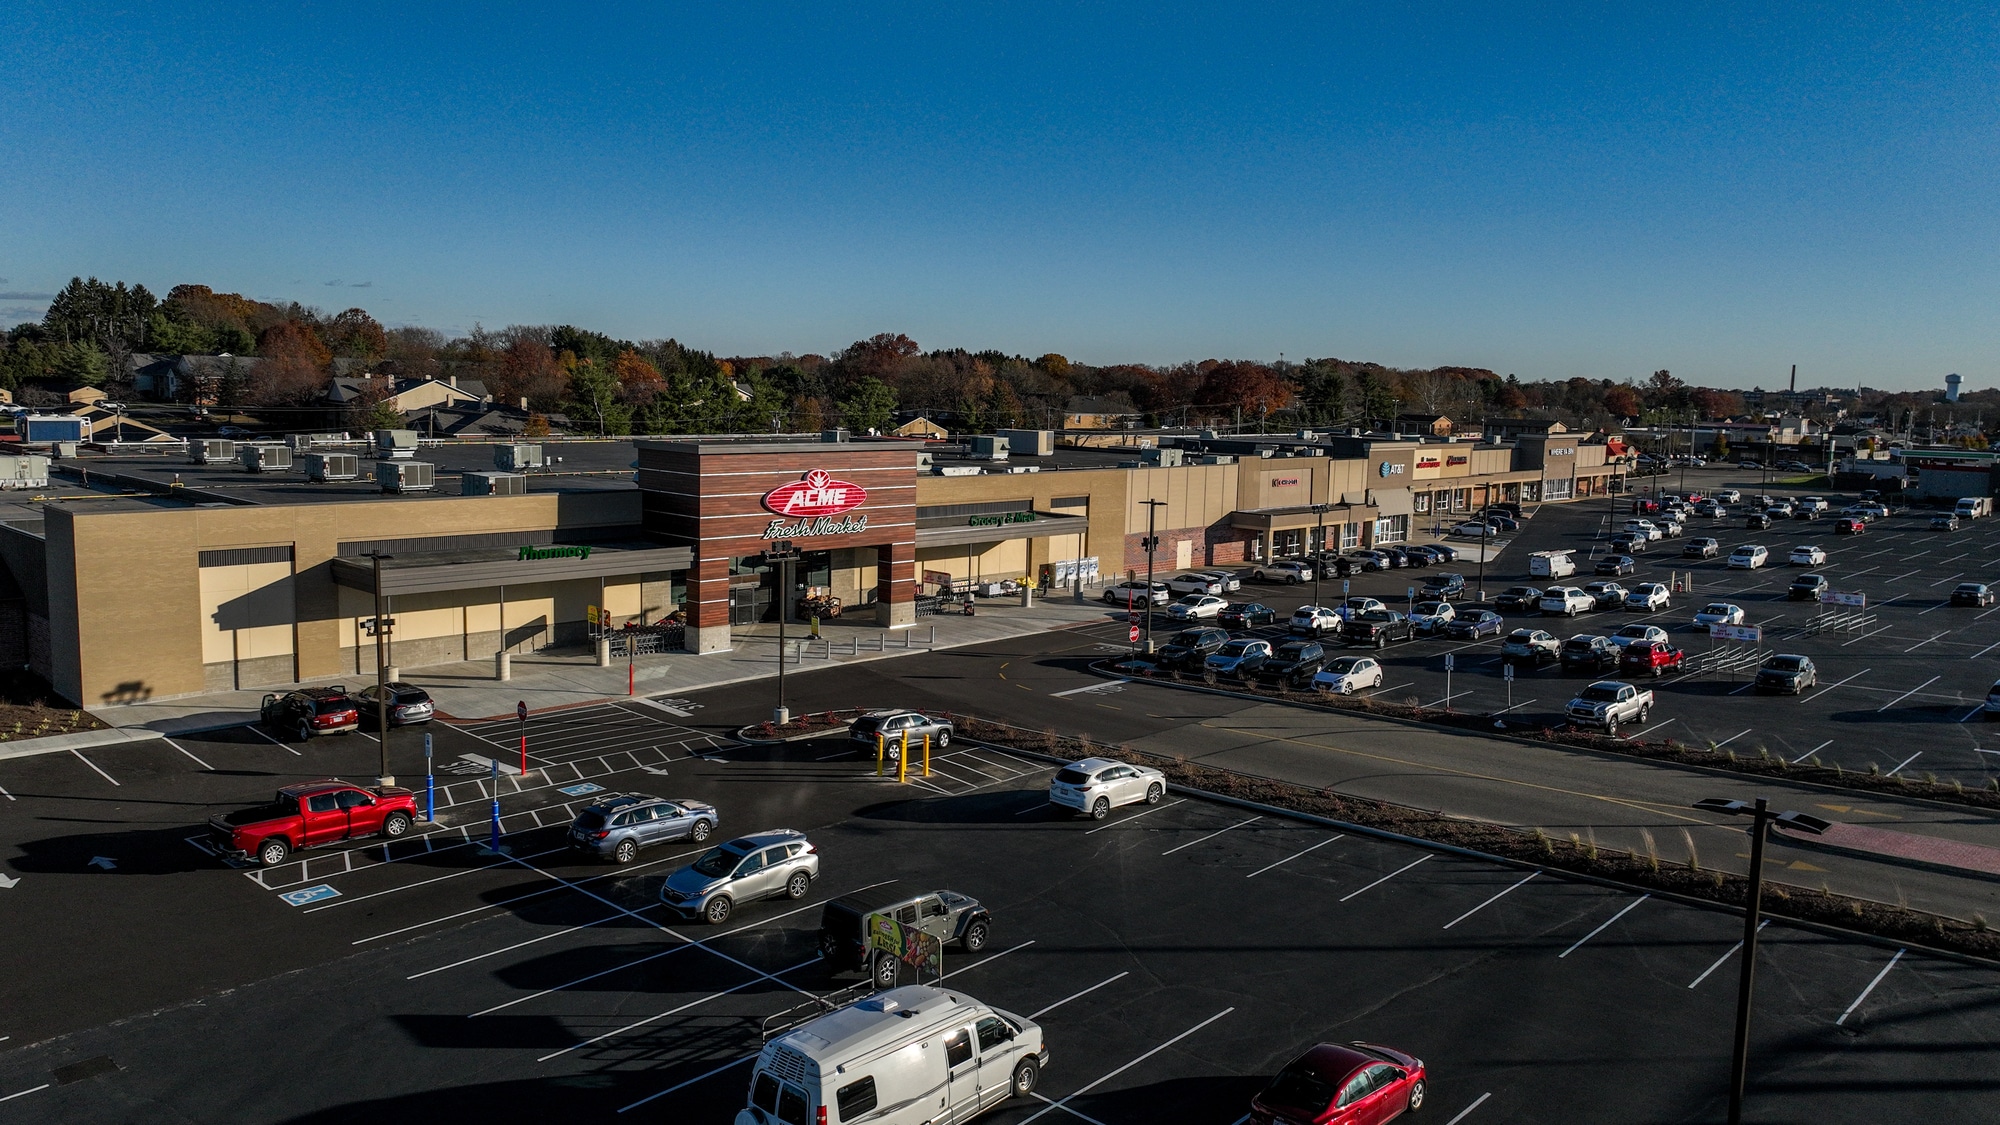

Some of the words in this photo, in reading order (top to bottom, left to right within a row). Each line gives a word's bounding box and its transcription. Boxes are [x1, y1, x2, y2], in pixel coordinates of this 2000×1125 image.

[1390, 463, 1405, 474] AT&T
[783, 488, 847, 513] ACME
[764, 518, 810, 540] Fresh
[811, 514, 868, 537] Market
[970, 514, 1004, 527] Grocery
[1014, 511, 1037, 523] Meat
[519, 545, 592, 561] Pharmacy
[1129, 615, 1141, 623] STOP
